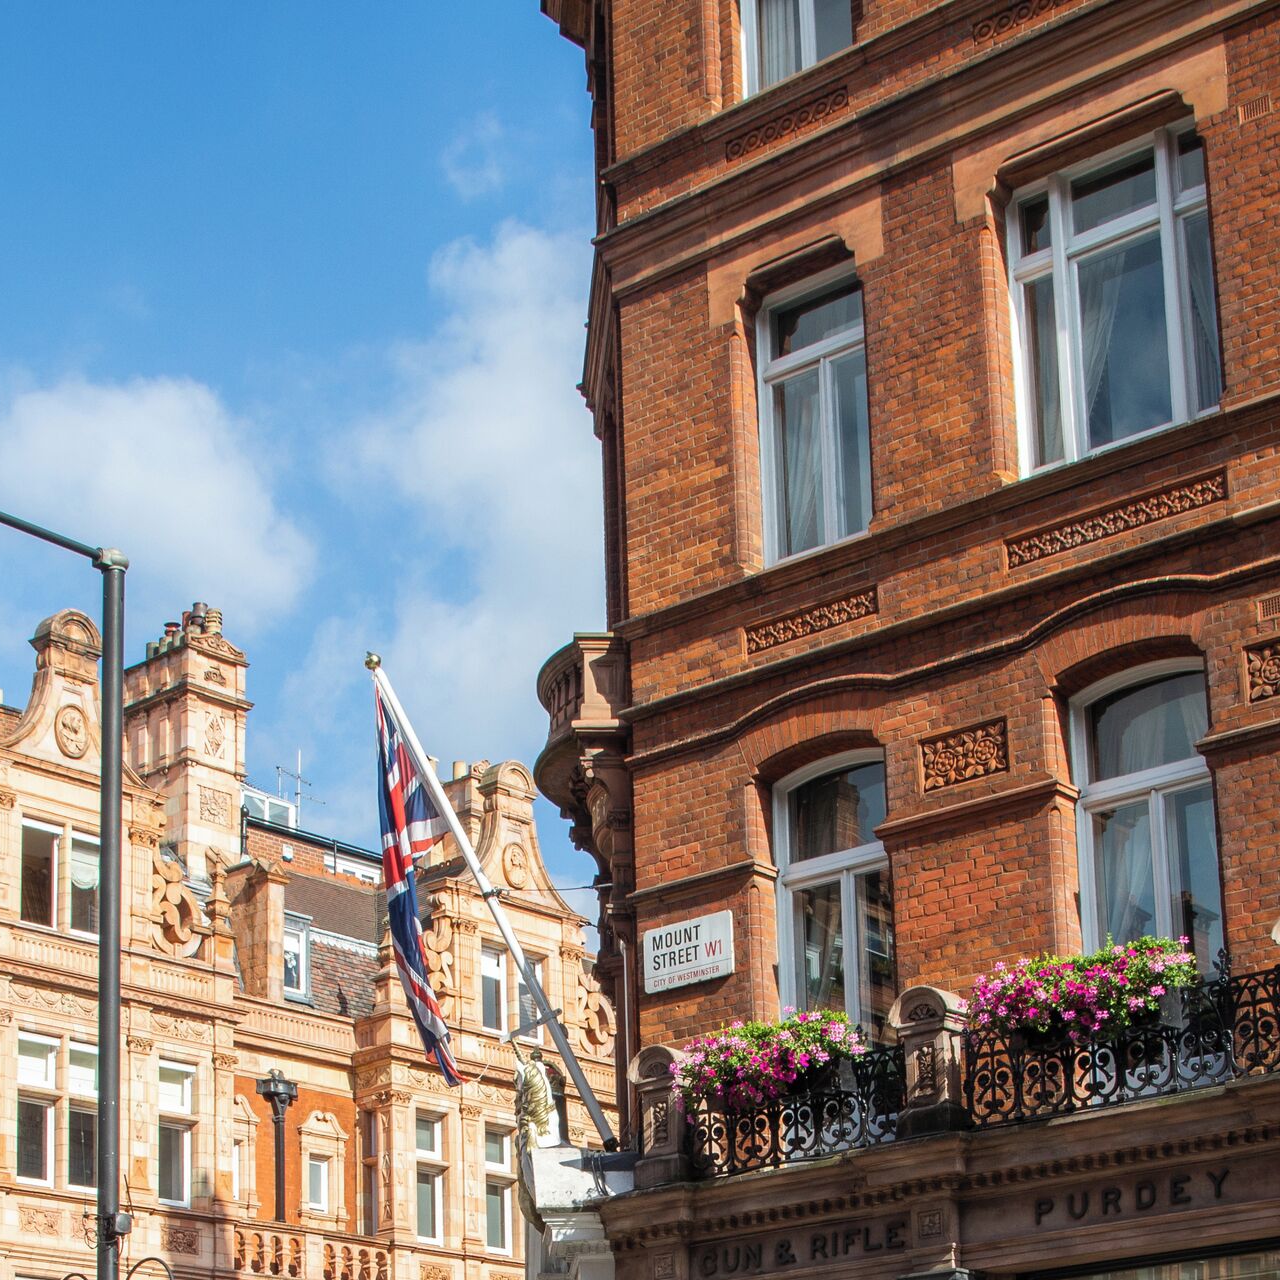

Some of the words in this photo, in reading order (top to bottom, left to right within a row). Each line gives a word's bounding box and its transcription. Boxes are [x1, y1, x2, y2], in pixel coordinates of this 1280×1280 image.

[652, 924, 701, 952] MOUNT
[652, 944, 700, 971] STREET
[704, 939, 723, 958] W1
[653, 977, 666, 988] CITY
[668, 976, 676, 985] OF
[677, 965, 720, 982] WESTMINSTER
[1034, 1167, 1230, 1227] PURDEY
[699, 1243, 763, 1278] GUN
[775, 1238, 797, 1266] &
[810, 1220, 906, 1261] RIFLE
